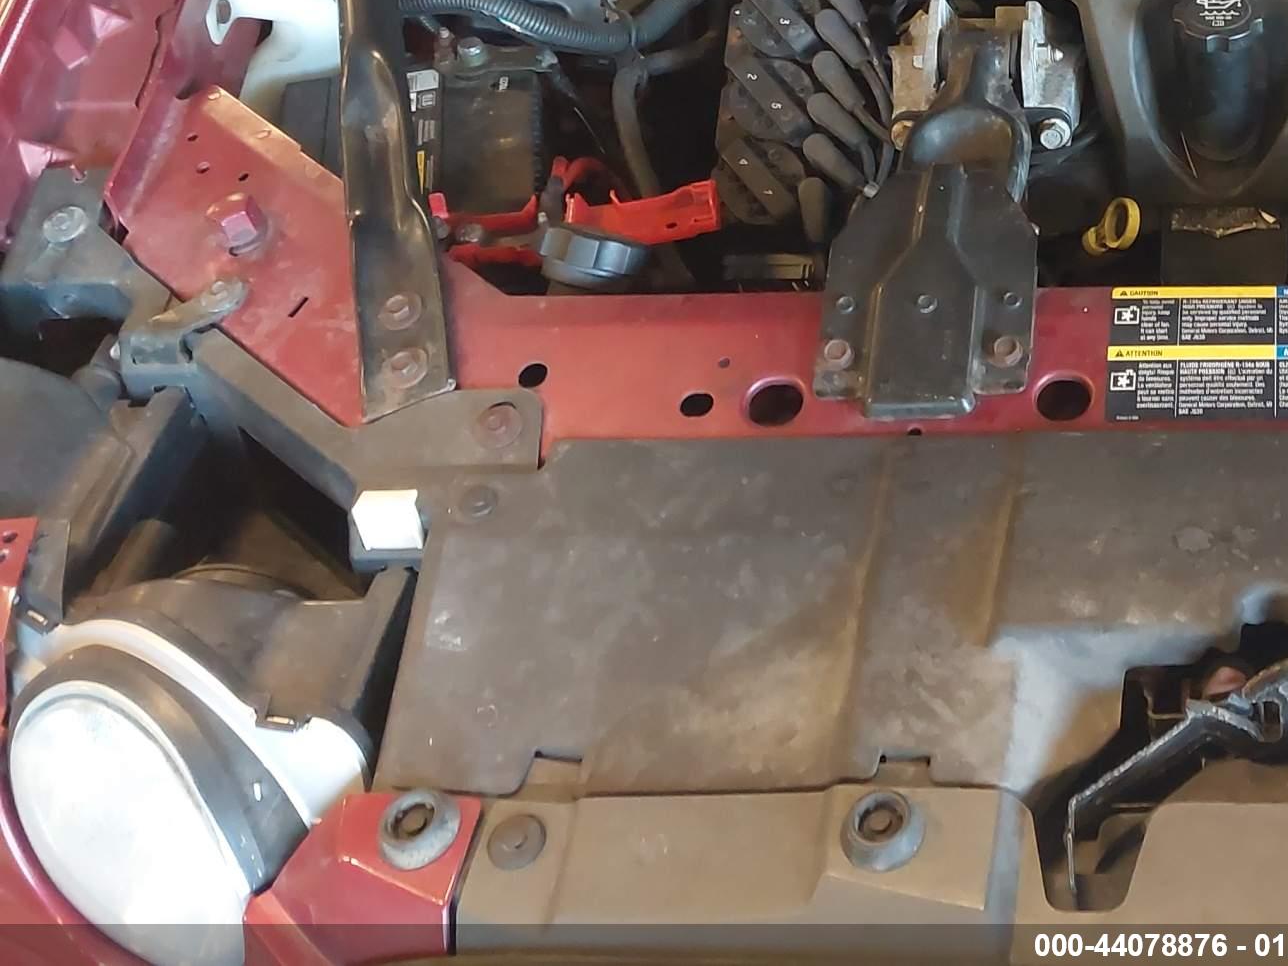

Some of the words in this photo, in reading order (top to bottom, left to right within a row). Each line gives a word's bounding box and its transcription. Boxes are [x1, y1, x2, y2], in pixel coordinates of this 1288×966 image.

[780, 17, 790, 26] 3
[747, 72, 758, 81] 2
[771, 102, 782, 110] 5
